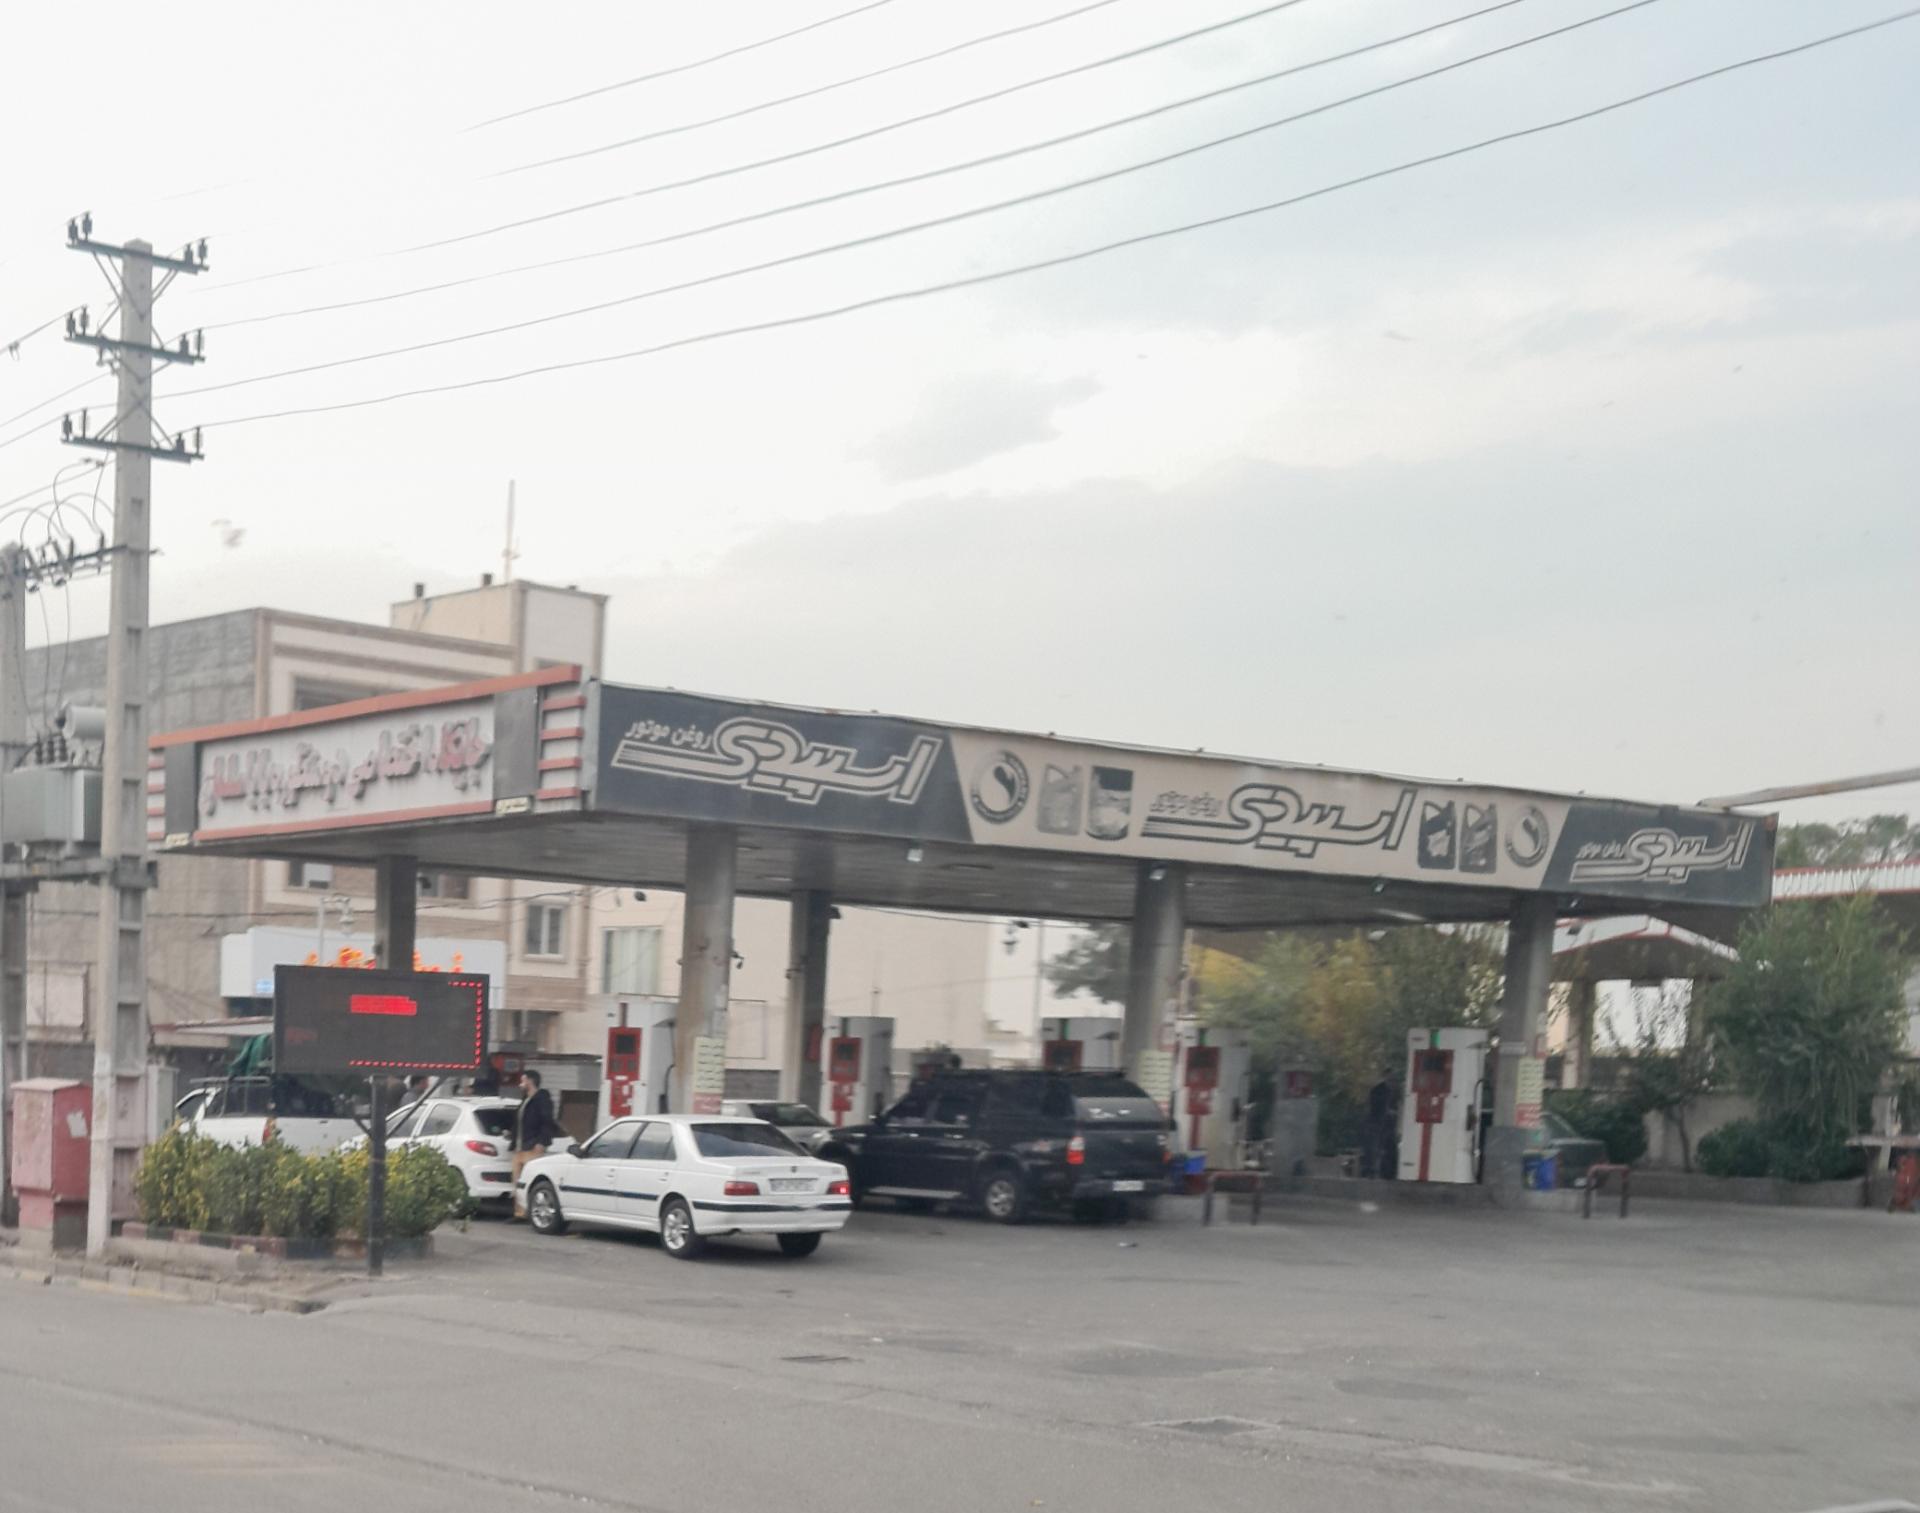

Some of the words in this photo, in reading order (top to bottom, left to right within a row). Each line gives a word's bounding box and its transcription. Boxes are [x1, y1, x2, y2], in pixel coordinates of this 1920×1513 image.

[611, 716, 943, 805] اسپیدی
[625, 717, 668, 741] موتور
[672, 727, 713, 751] روغن
[1139, 782, 1418, 858] اسپیدی
[1569, 819, 1756, 884] اسپیدی
